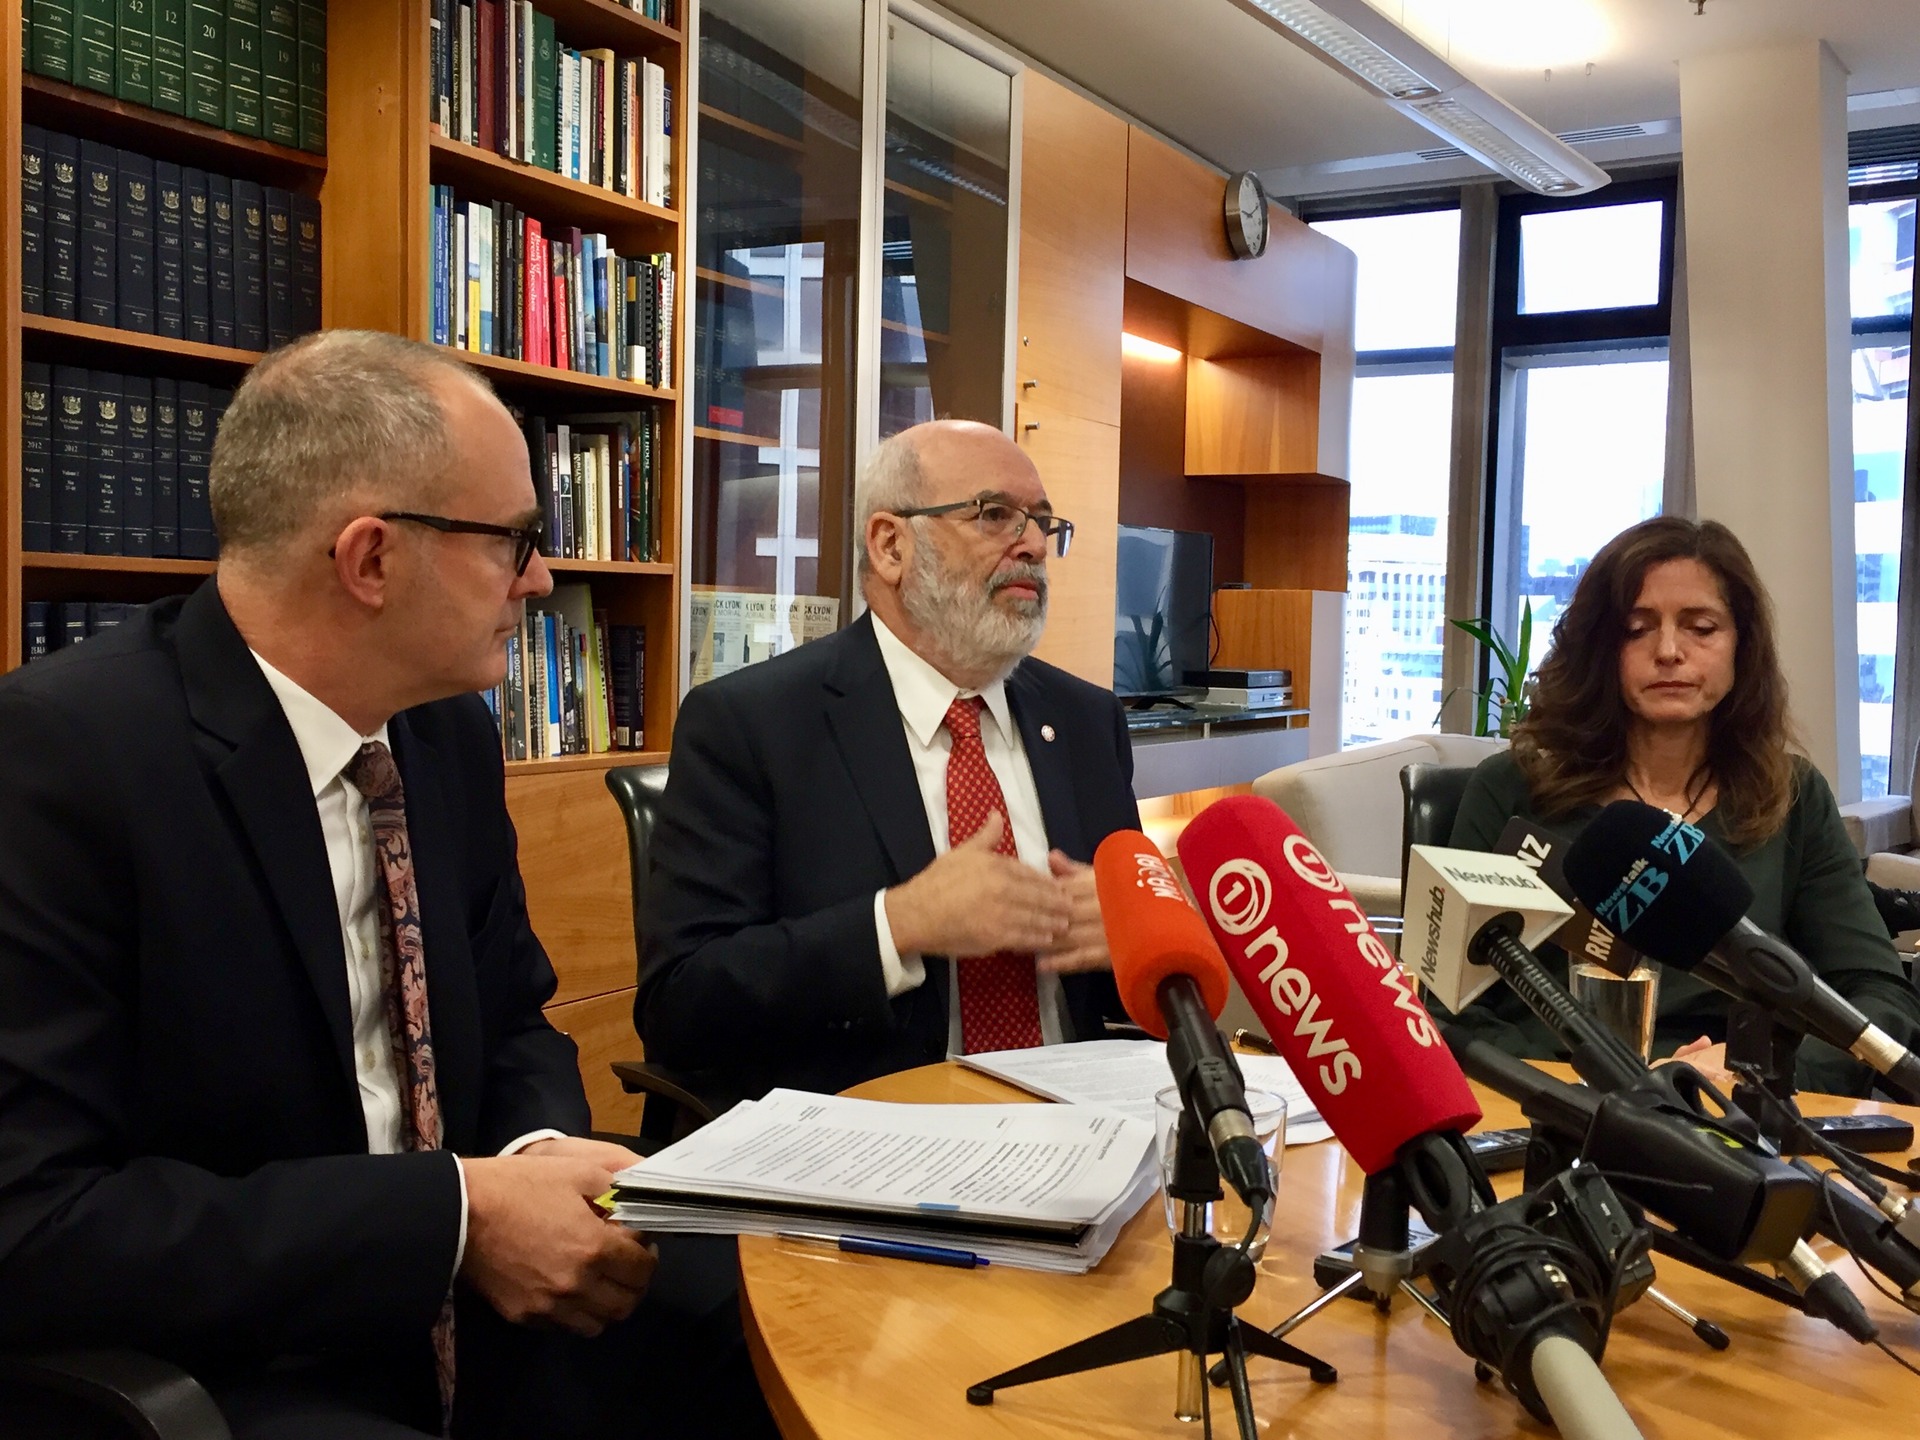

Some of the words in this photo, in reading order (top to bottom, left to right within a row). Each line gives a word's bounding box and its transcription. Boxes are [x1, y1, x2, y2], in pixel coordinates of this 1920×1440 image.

[129, 0, 143, 13] 42
[165, 10, 176, 24] 12
[203, 25, 215, 39] 20
[240, 39, 252, 51] 14
[278, 50, 288, 63] 19
[572, 60, 580, 125] GLOBALISATION
[28, 441, 42, 449] 2012
[64, 444, 78, 452] 2012
[101, 448, 113, 457] 2012
[724, 600, 741, 609] LYON
[749, 603, 764, 612] LYON
[805, 605, 813, 614] CK
[814, 606, 831, 615] LYON
[805, 614, 832, 622] MORIAL
[1663, 821, 1706, 866] ZB
[1516, 833, 1552, 877] NZ
[1594, 857, 1650, 917] Newstalk
[1606, 866, 1669, 934] ZB
[1328, 899, 1441, 1048] news
[1244, 925, 1363, 1096] news
